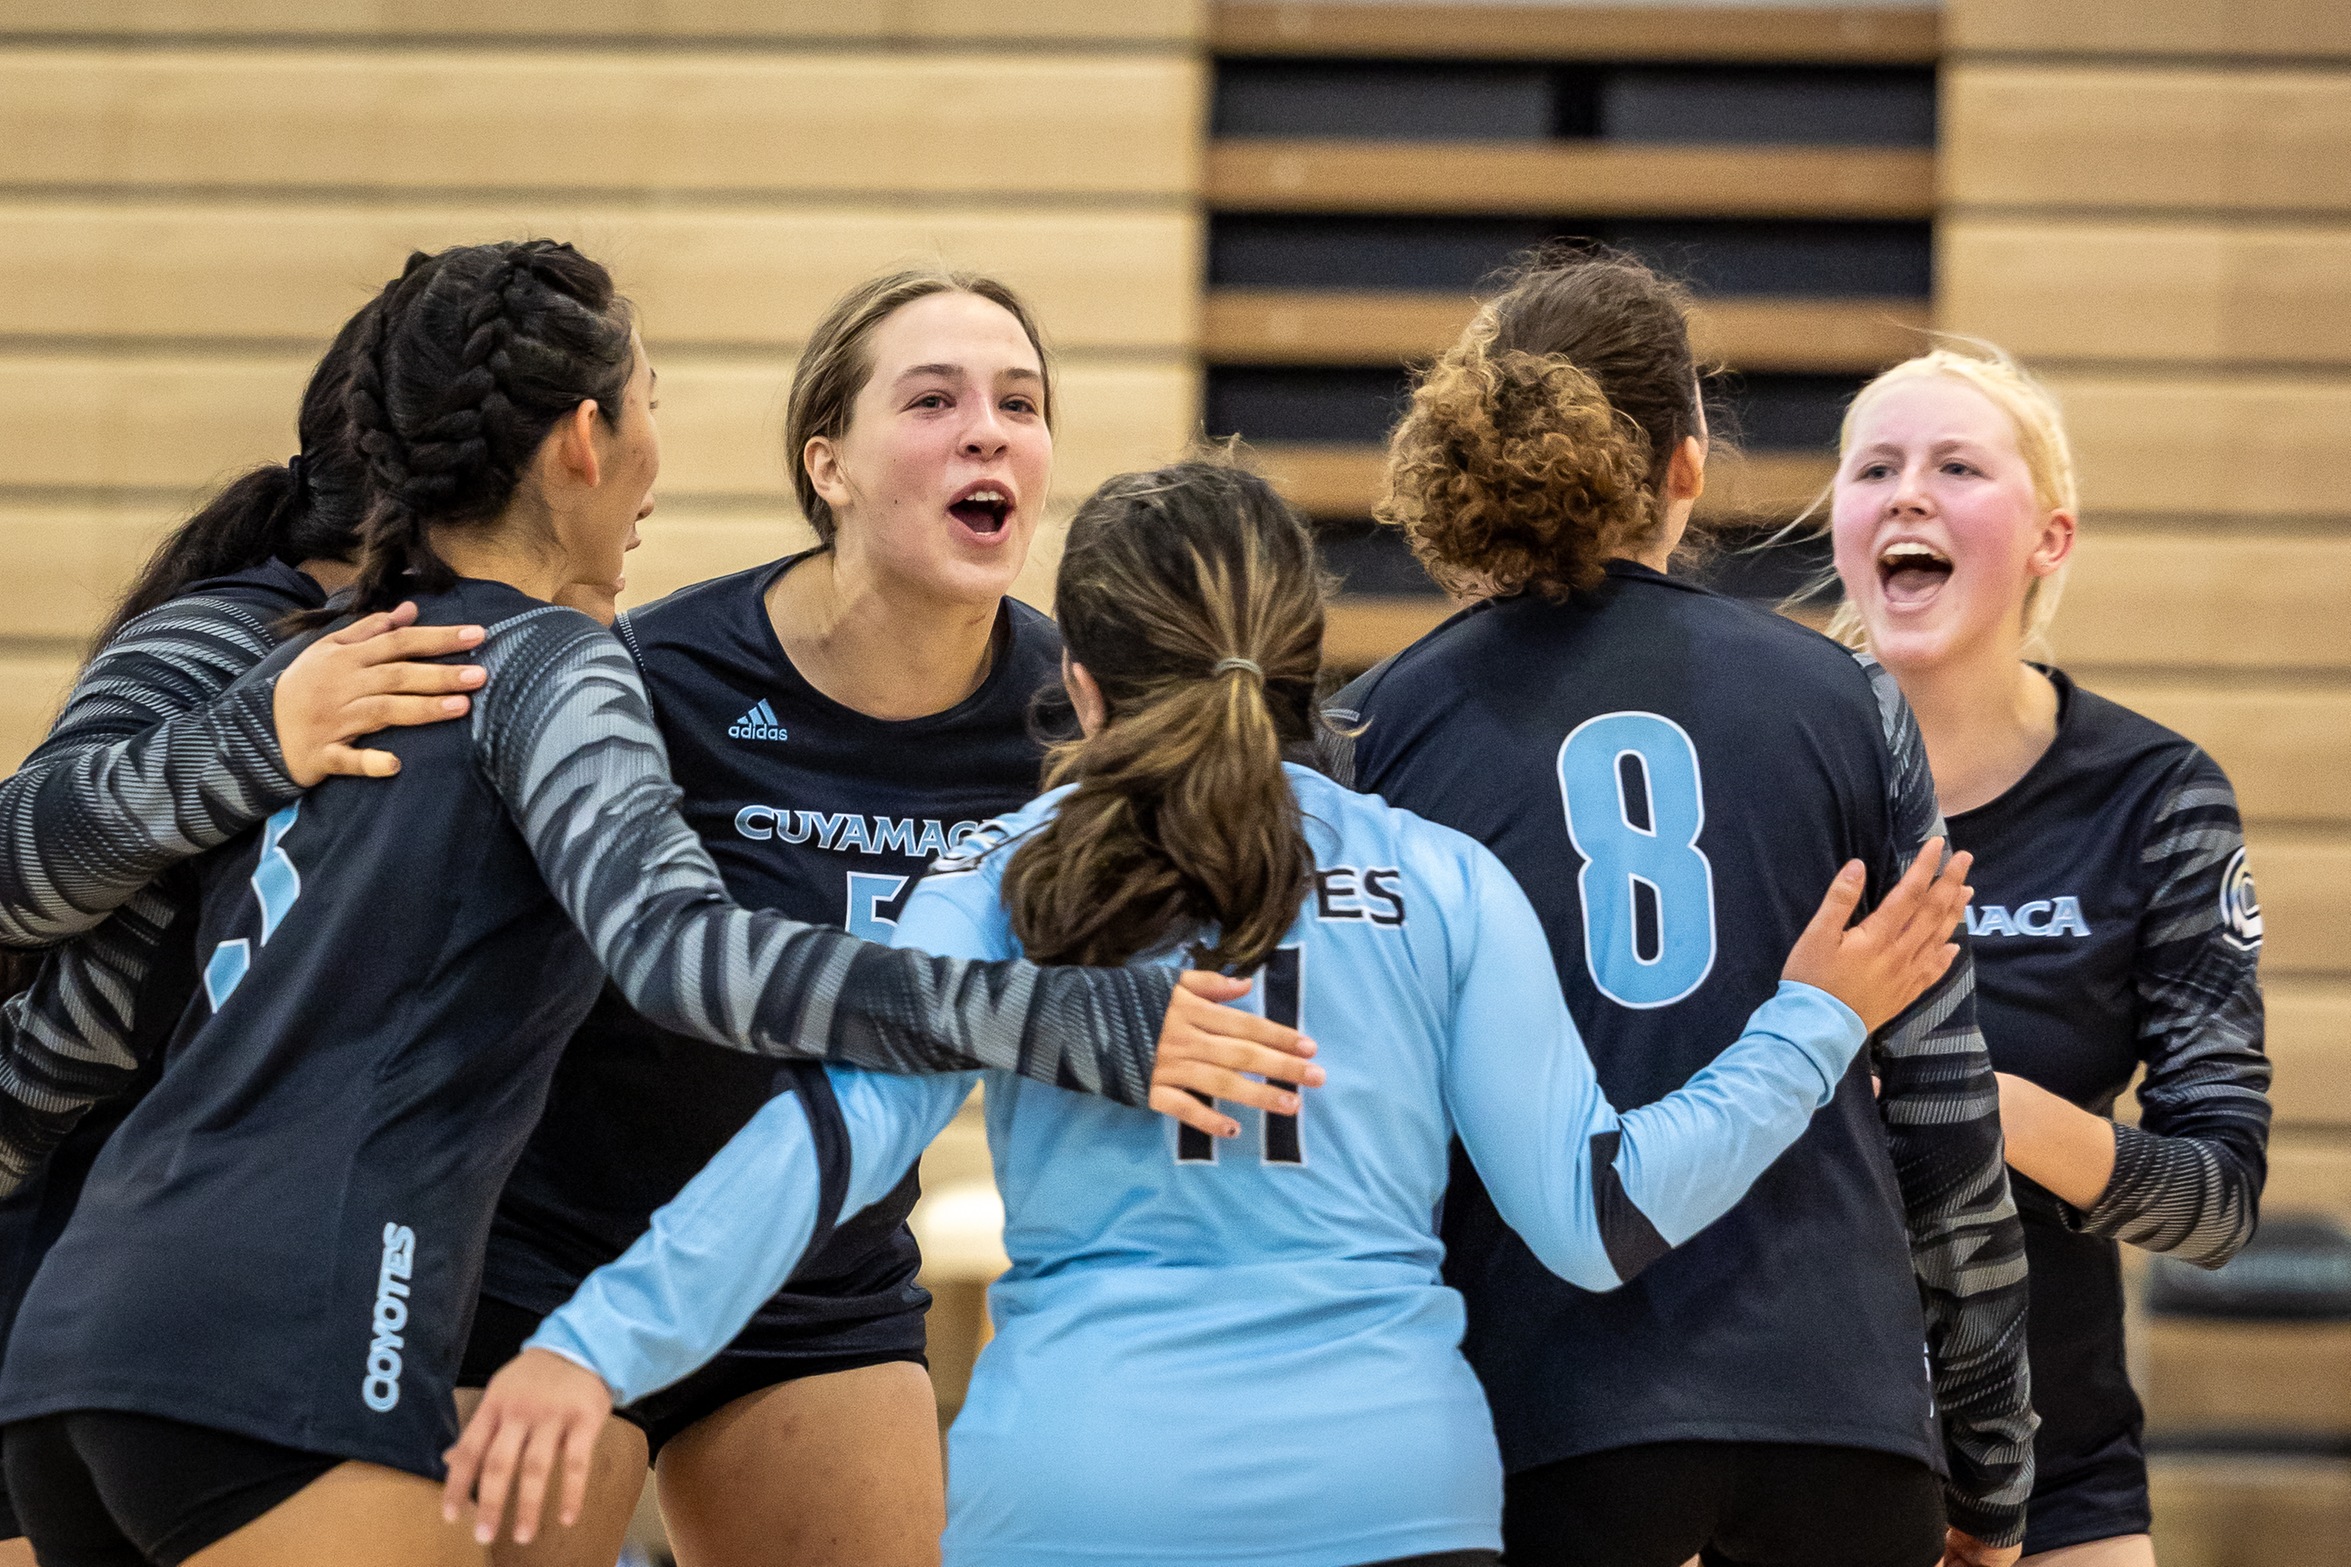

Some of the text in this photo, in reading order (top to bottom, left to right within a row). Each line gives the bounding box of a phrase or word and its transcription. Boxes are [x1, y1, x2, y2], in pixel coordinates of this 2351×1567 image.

[728, 722, 788, 742] adidas
[734, 804, 993, 857] CUYAMAC
[1556, 710, 1718, 1010] 8
[362, 1221, 416, 1412] COYOTES
